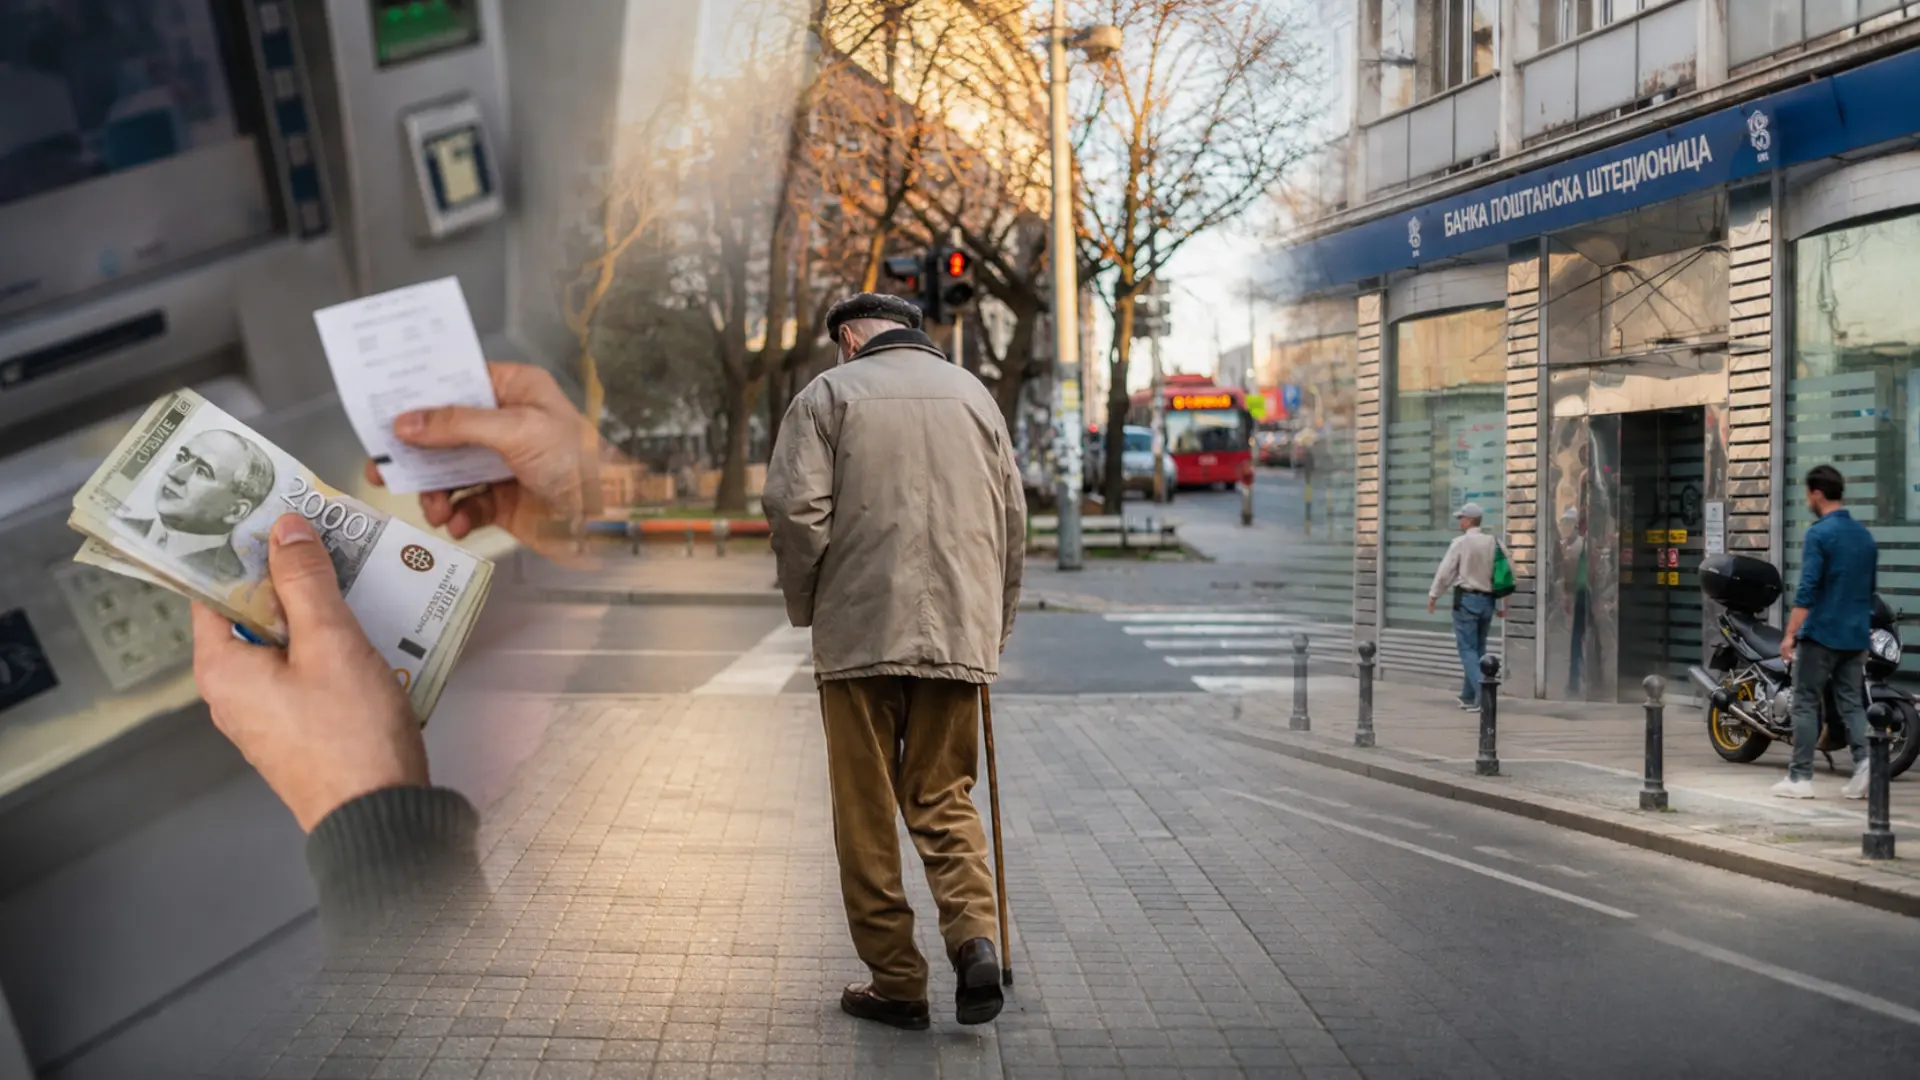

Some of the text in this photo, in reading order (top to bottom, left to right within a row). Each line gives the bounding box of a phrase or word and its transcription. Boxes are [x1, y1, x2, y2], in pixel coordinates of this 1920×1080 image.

[1444, 134, 1713, 237] БАНКА ПОШТАНСКА ШТЕДИОНИЦА
[280, 475, 370, 541] 2000
